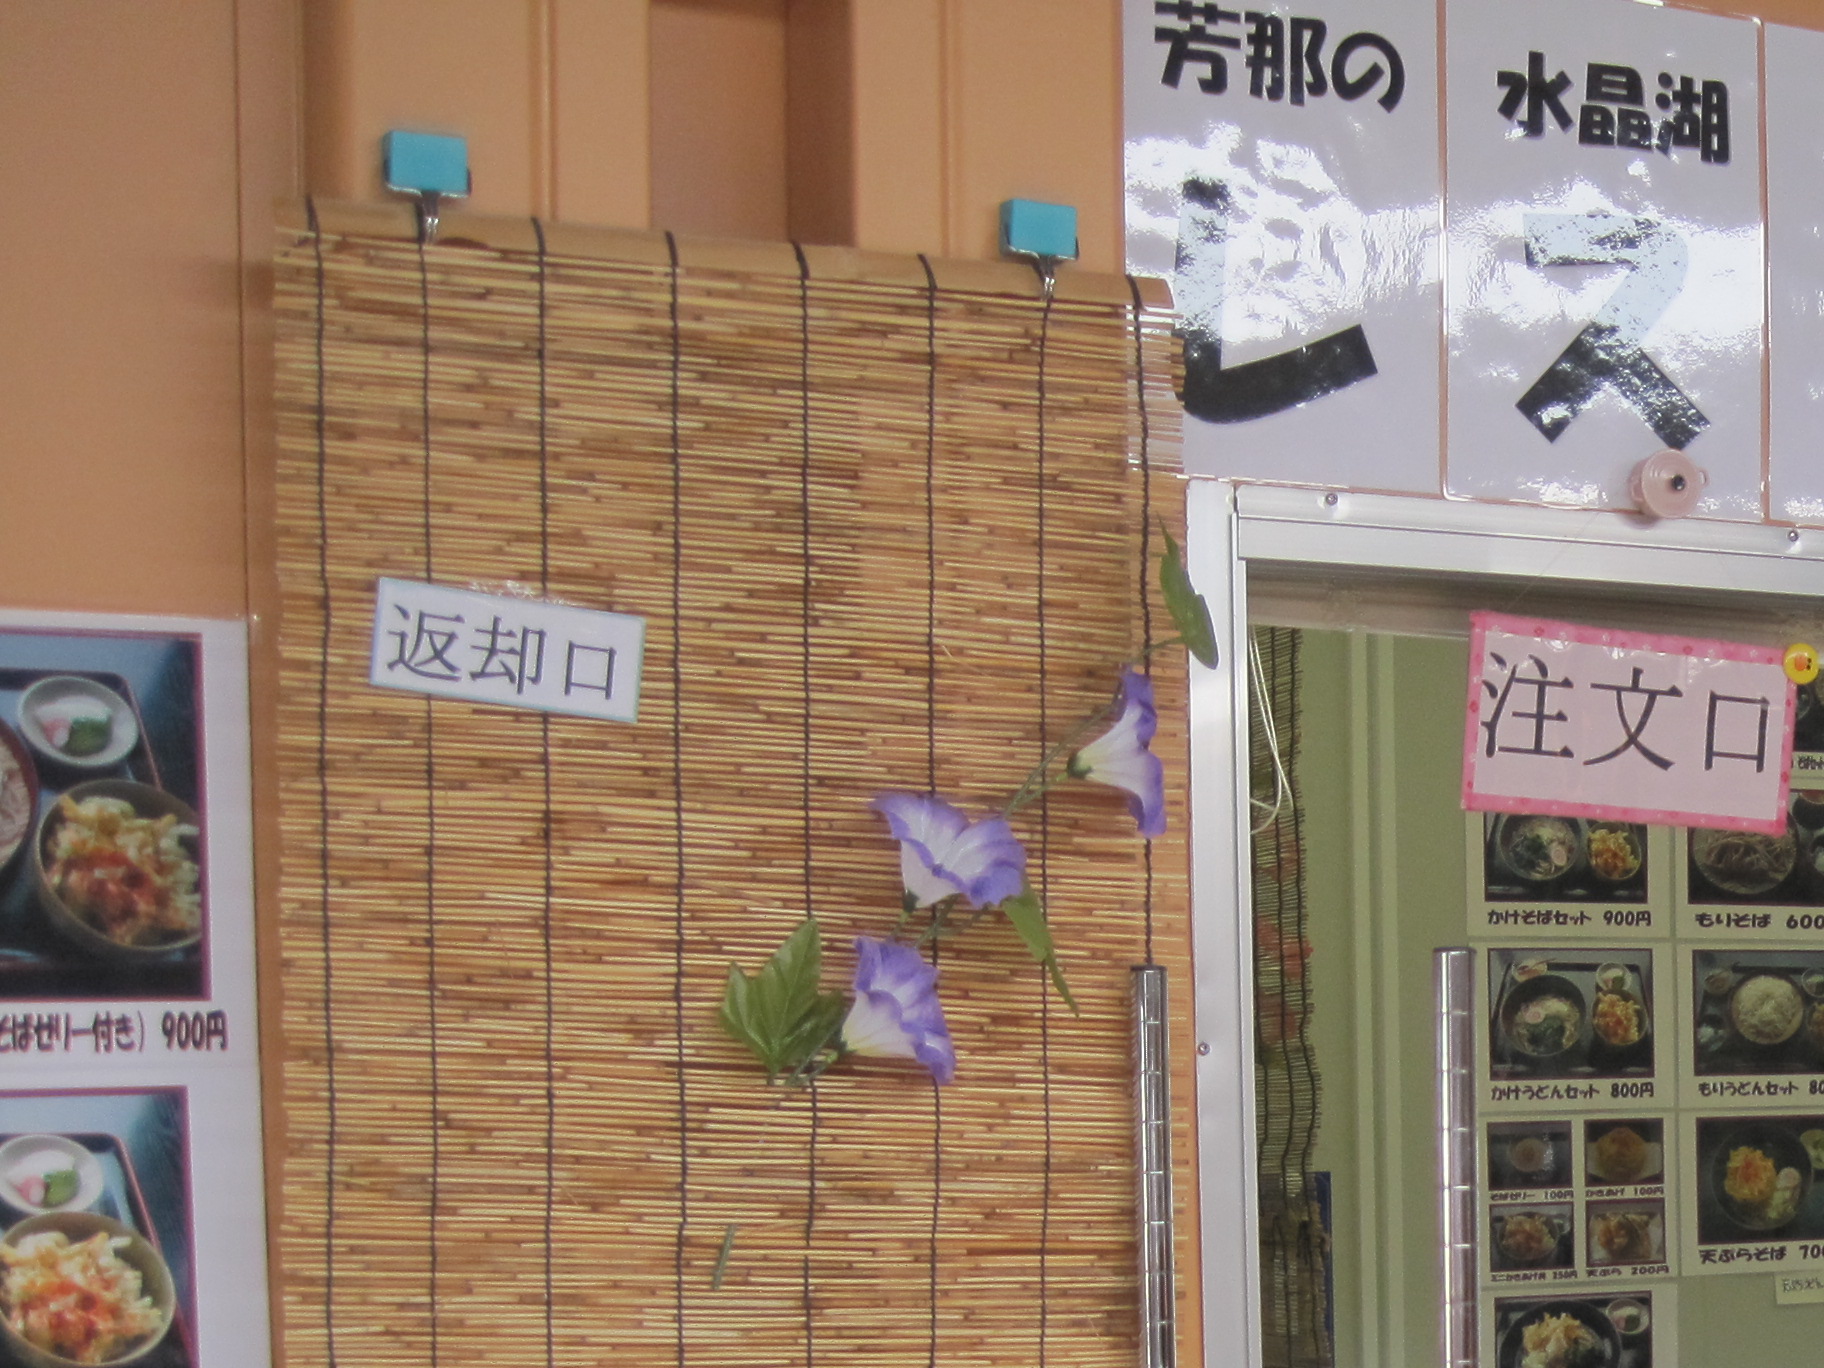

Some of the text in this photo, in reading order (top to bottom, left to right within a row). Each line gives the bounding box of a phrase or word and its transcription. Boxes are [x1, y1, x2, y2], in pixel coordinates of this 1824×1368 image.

[1154, 0, 1406, 112] 芳那の
[1496, 51, 1732, 164] 水晶湖
[387, 604, 619, 700] 返却口
[1480, 650, 1771, 774] 注文口
[1487, 908, 1653, 928] かけそばセット 900円
[1695, 912, 1772, 929] もりそば
[162, 1008, 230, 1053] 900円
[1490, 1081, 1655, 1102] かけうどんセット 800円
[1698, 1082, 1799, 1098] もりうどんセット
[1543, 1189, 1574, 1200] 100円
[1633, 1185, 1665, 1197] 100円
[1699, 1245, 1787, 1265] 天ぷらそば
[1631, 1264, 1670, 1276] 200円
